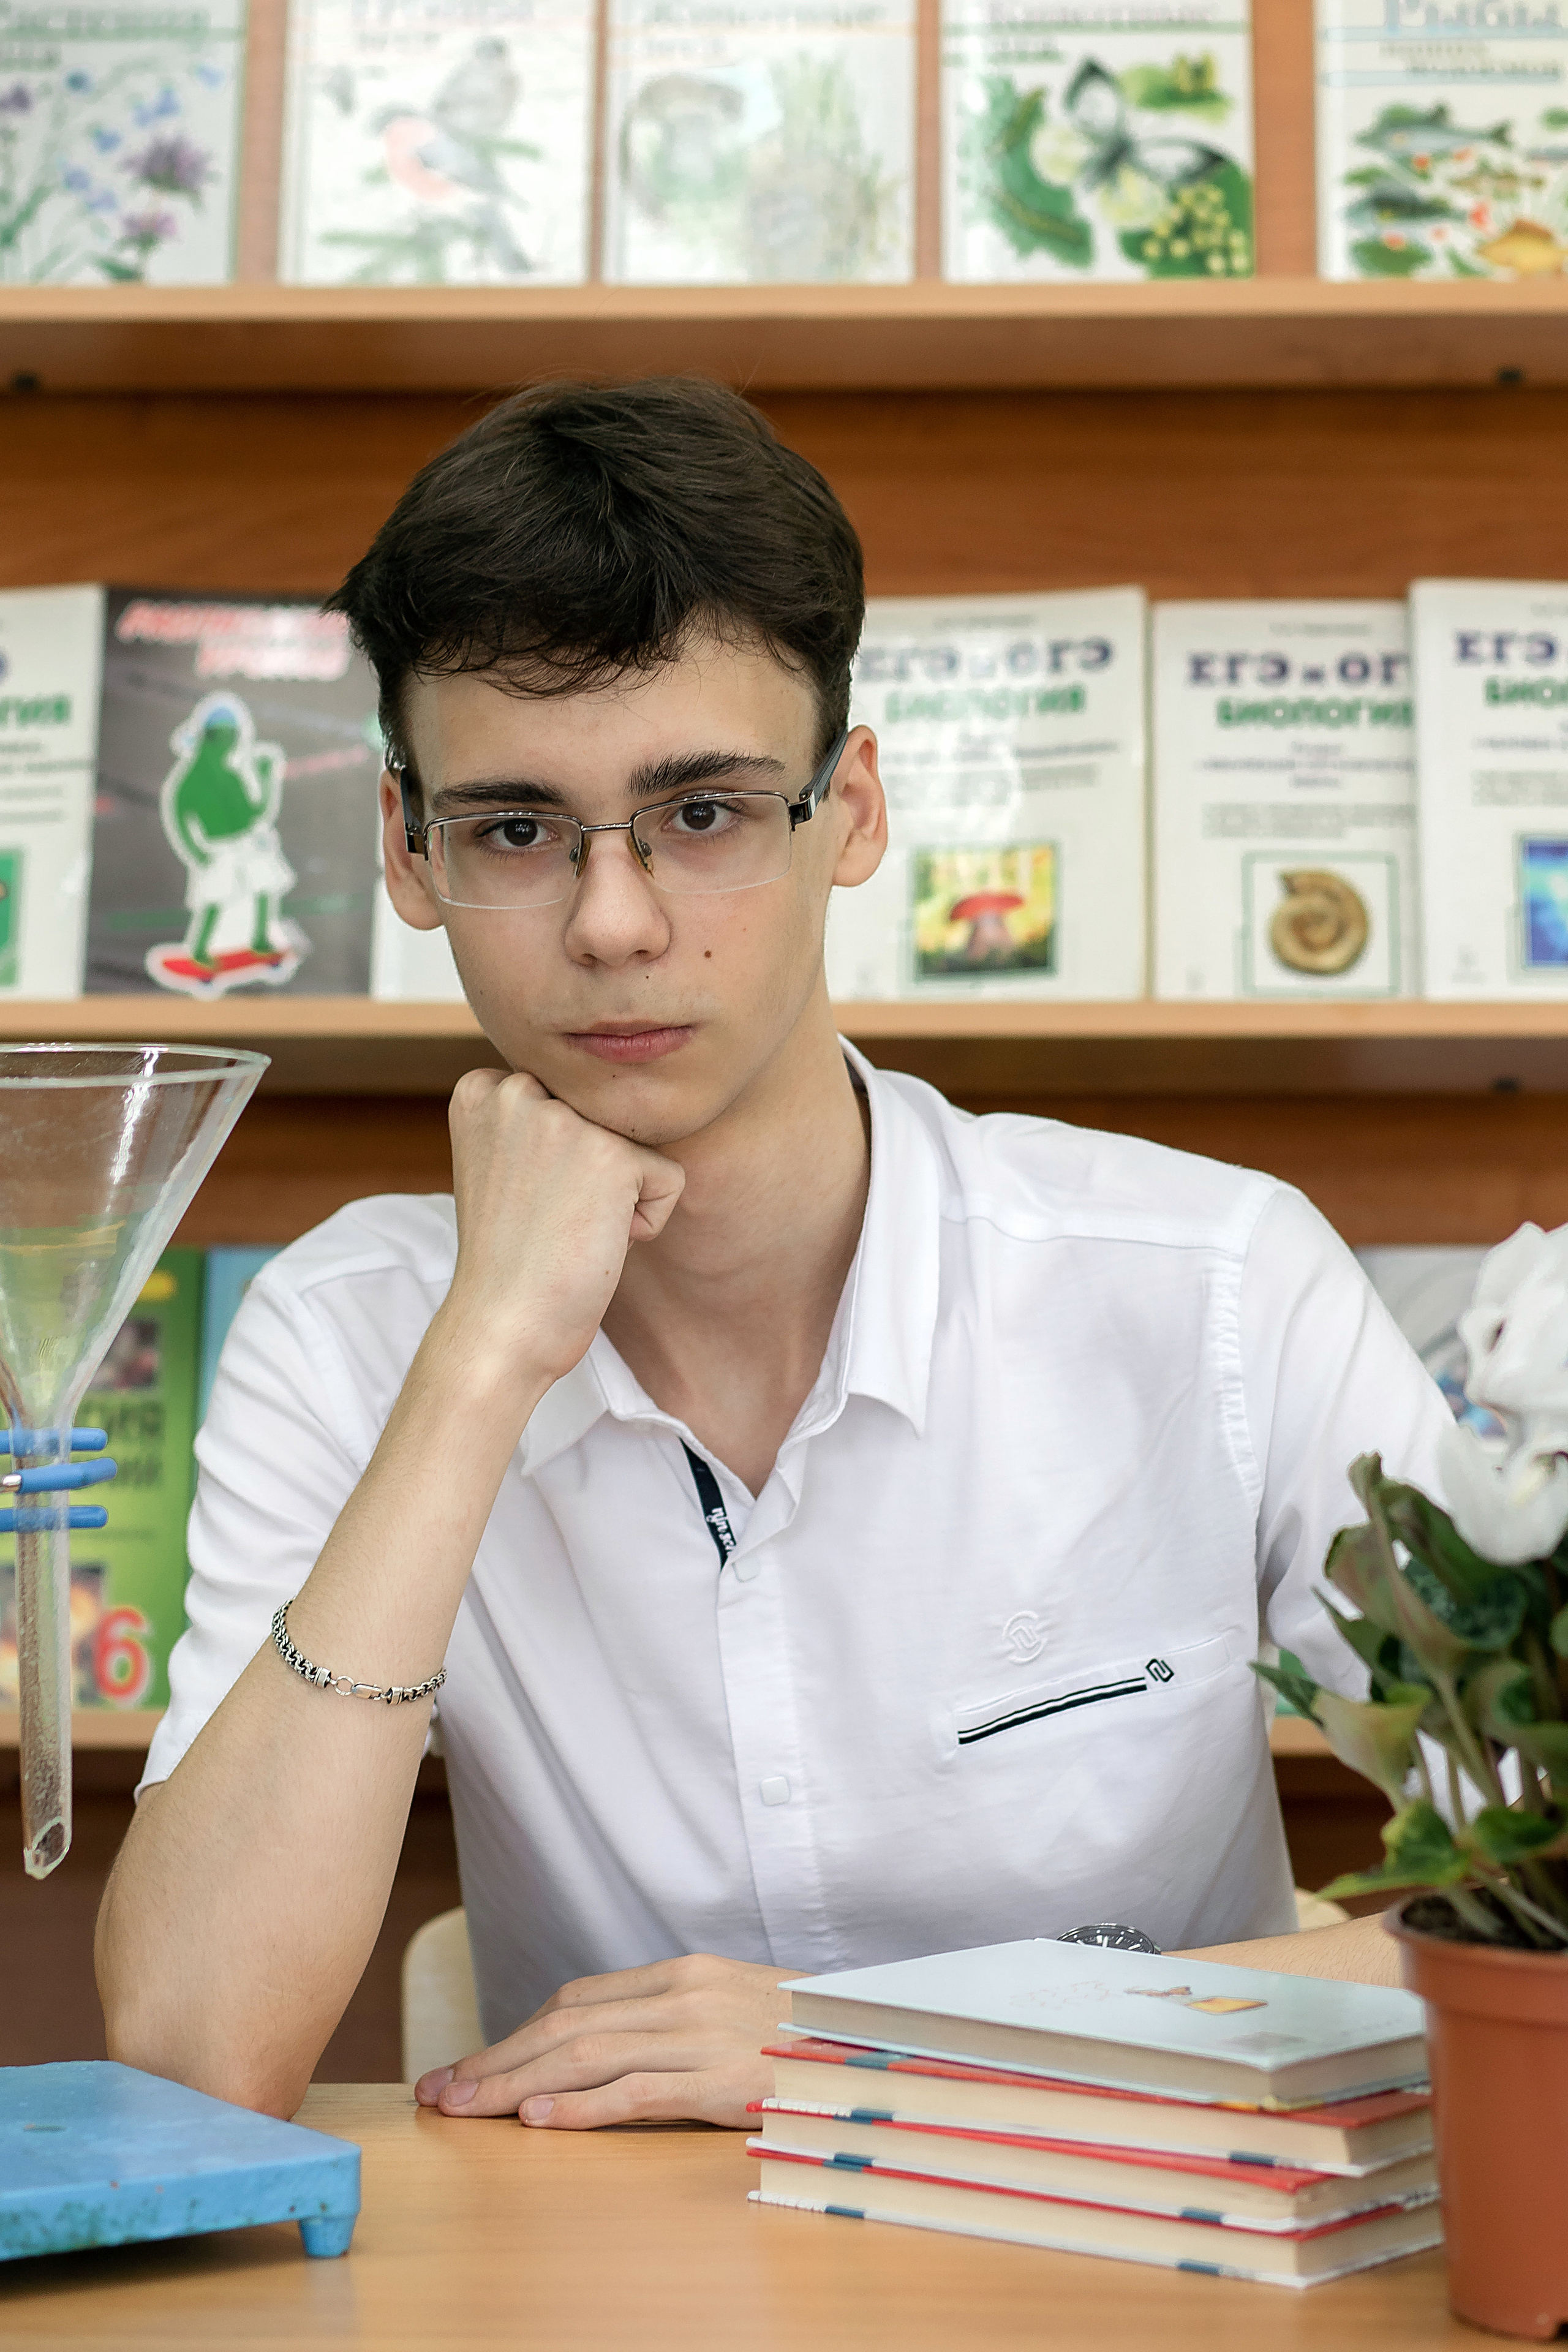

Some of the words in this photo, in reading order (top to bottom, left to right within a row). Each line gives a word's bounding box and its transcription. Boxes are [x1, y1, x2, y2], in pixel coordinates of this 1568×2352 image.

[1454, 630, 1557, 666] ЕГЭ
[1187, 650, 1289, 687] ЕГЭ
[94, 1606, 151, 1700] 6
